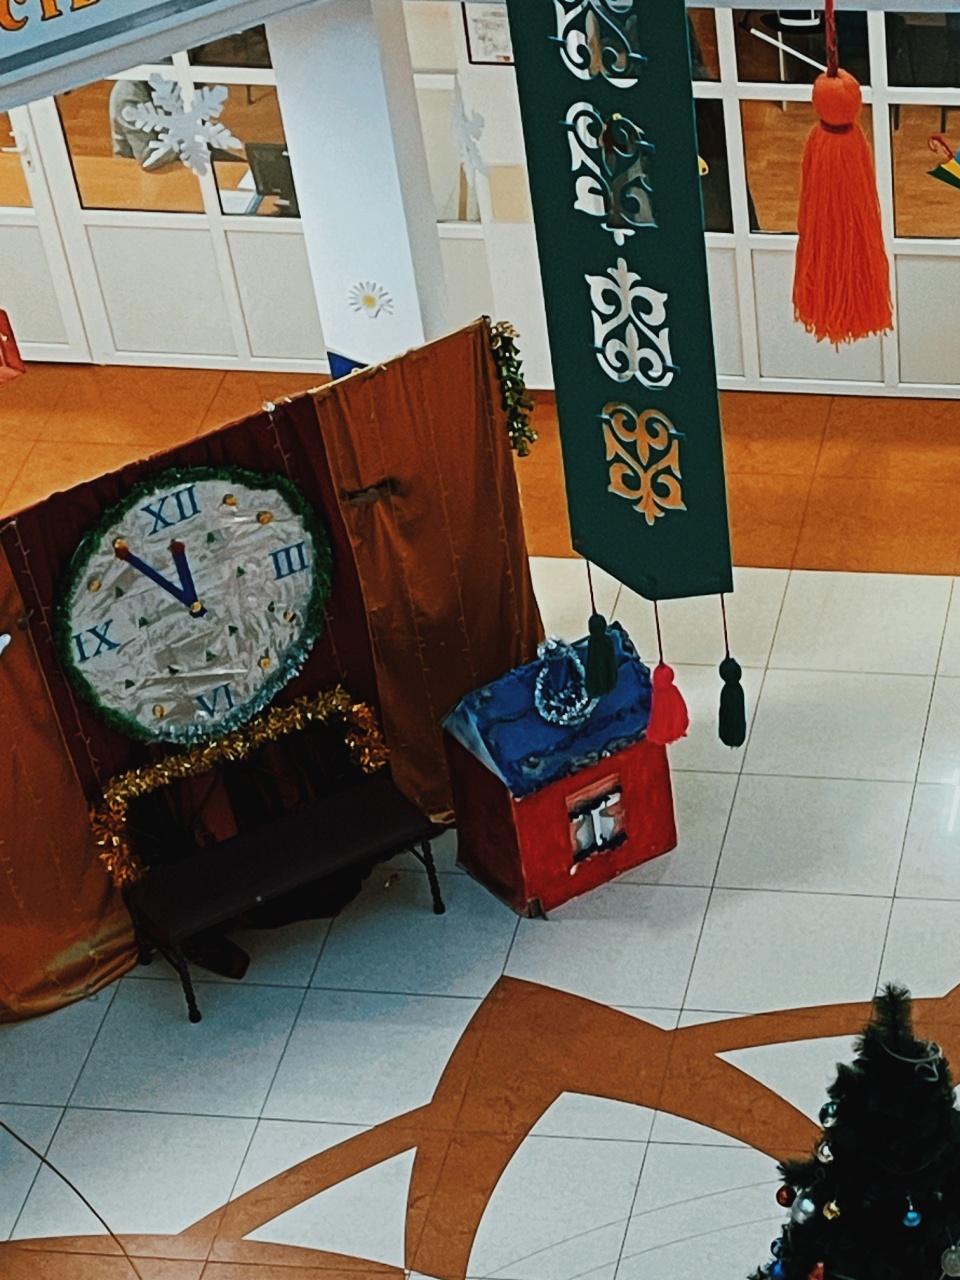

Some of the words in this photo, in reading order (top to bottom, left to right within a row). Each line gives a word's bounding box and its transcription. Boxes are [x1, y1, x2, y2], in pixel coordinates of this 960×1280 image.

[141, 485, 202, 536] XII
[268, 541, 309, 581] III
[71, 618, 121, 663] IX
[197, 683, 235, 718] VI
